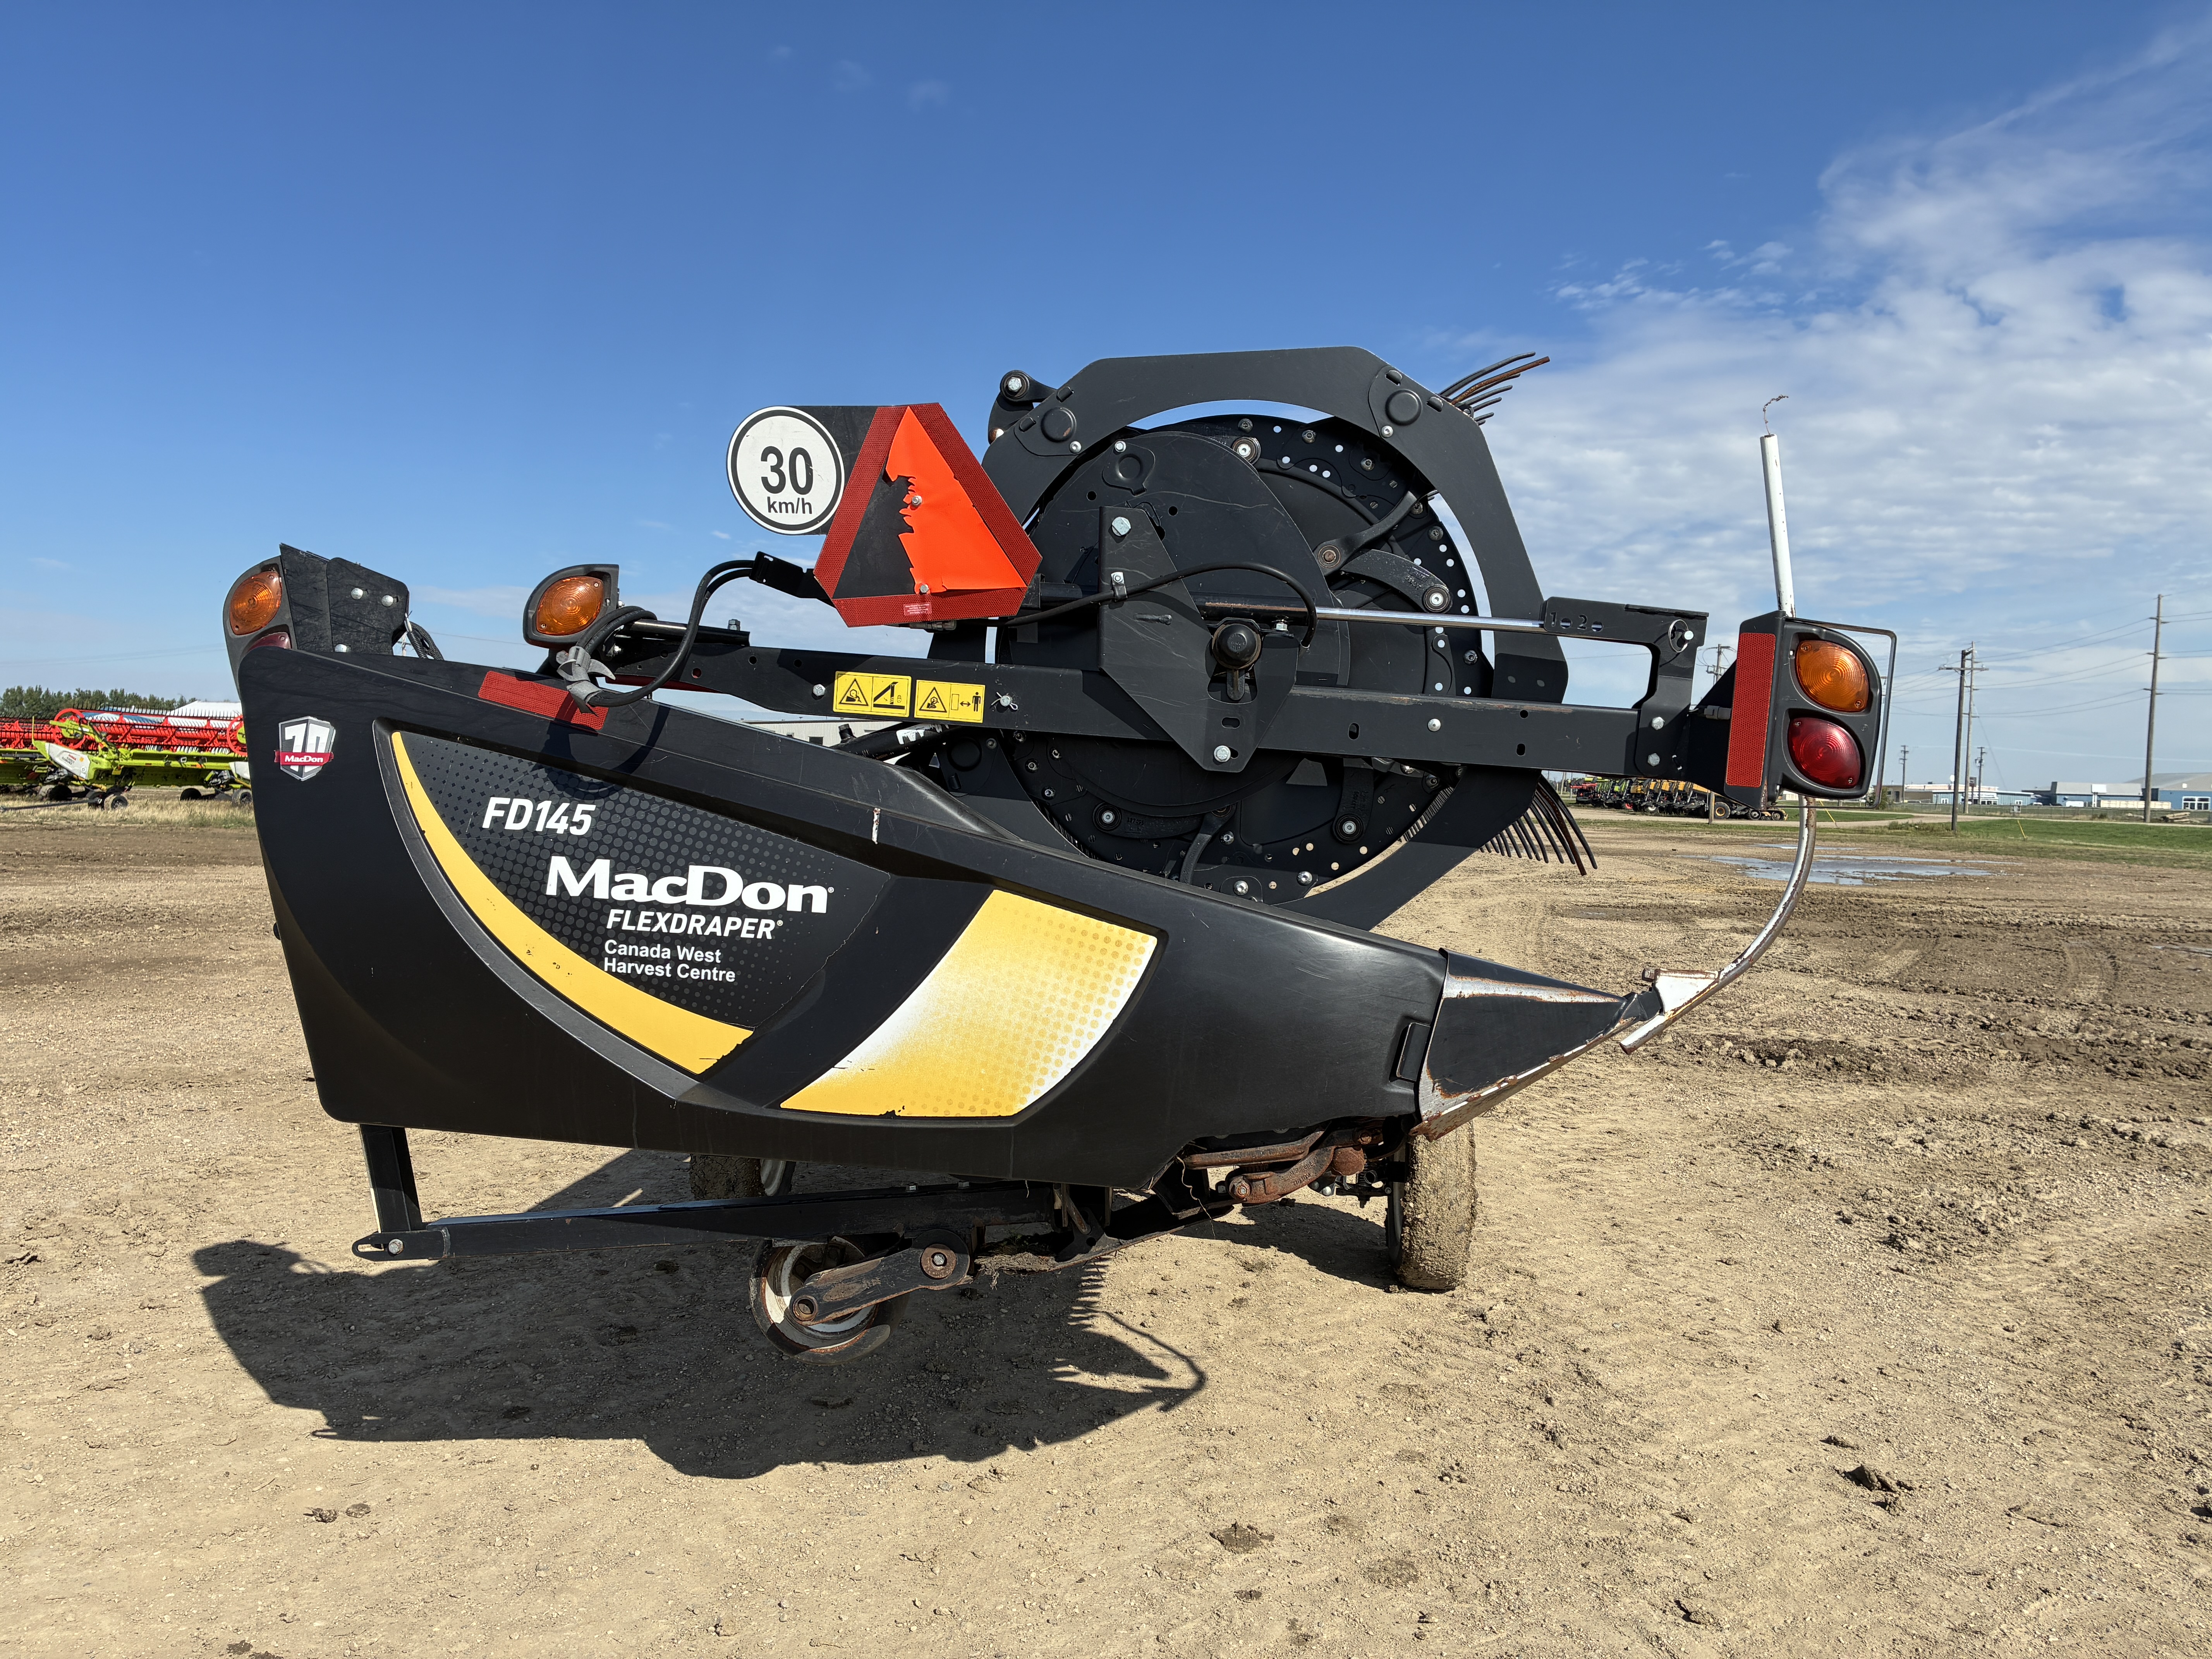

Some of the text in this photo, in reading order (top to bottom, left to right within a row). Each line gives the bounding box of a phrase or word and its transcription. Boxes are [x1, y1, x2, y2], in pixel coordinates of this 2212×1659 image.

[761, 446, 813, 495] 30
[767, 496, 812, 514] km/h
[1550, 611, 1587, 630] 1 2
[285, 755, 323, 763] MacDon
[482, 797, 596, 835] FD145
[605, 939, 721, 963] Canada West
[604, 957, 735, 982] Harvest Centre
